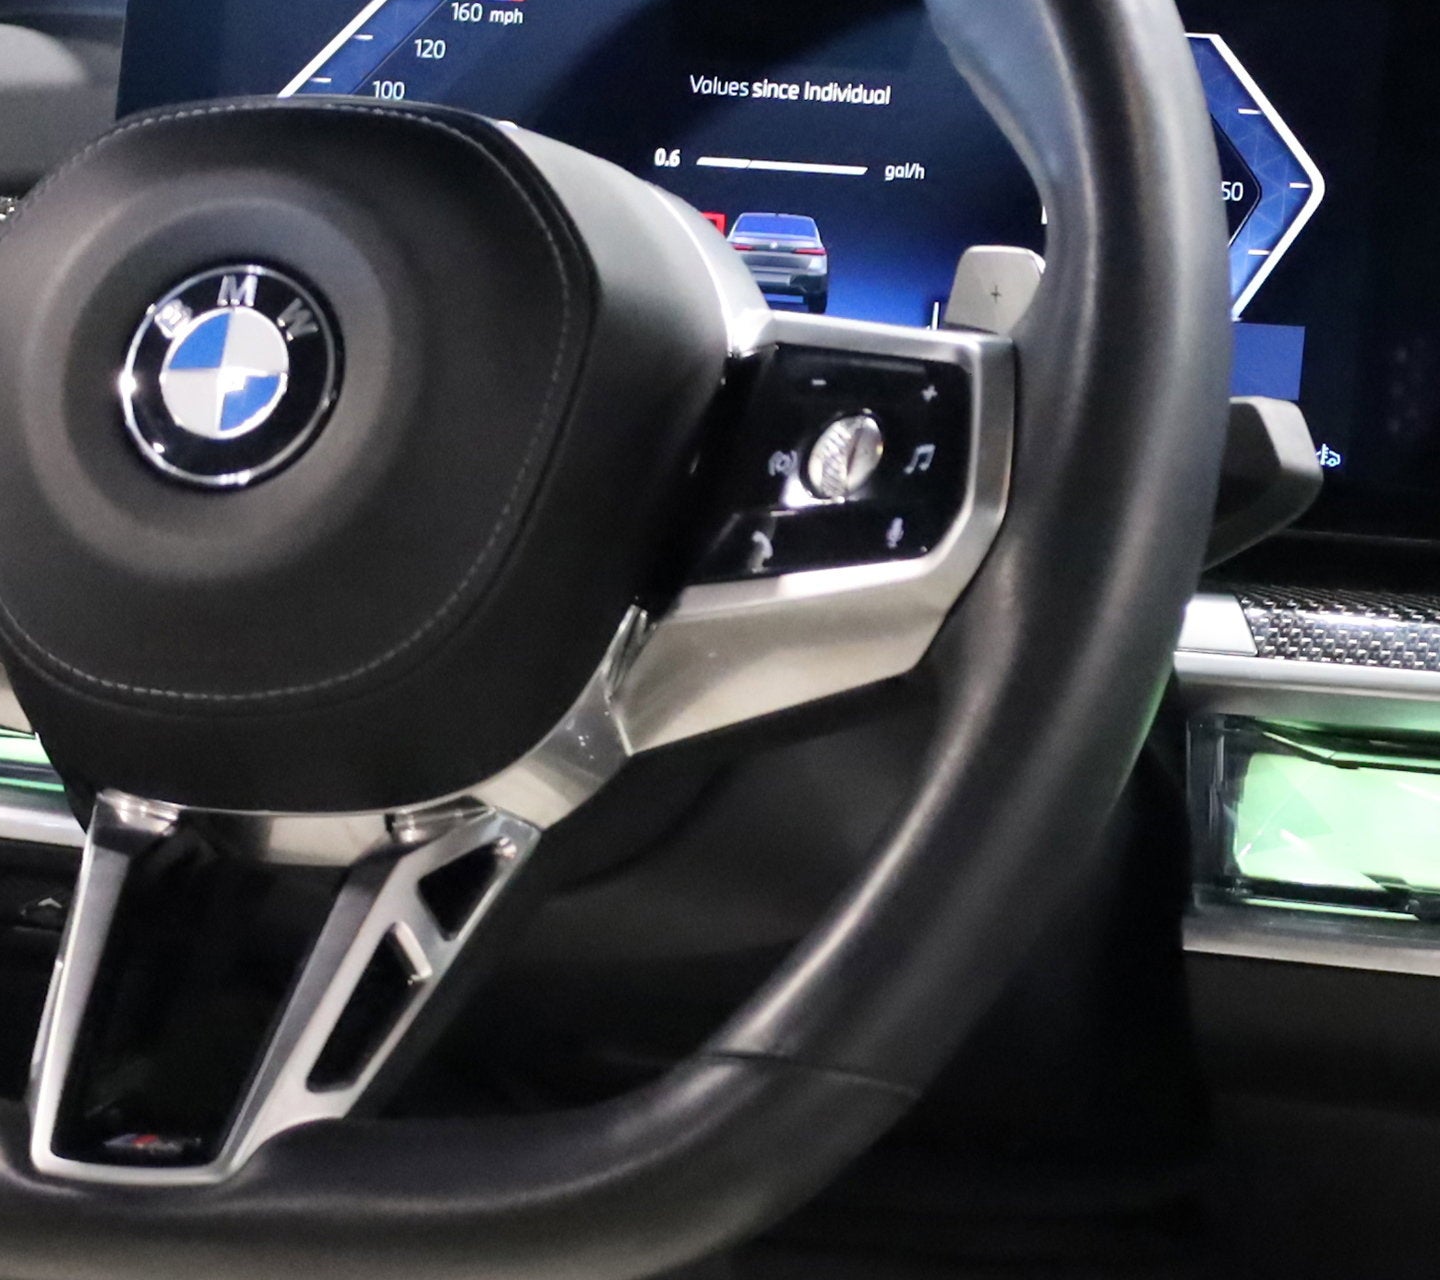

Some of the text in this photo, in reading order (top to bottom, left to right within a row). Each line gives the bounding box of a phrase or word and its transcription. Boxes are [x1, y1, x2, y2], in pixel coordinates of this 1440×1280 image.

[450, 1, 524, 26] 160 mph
[413, 38, 447, 60] 120
[372, 79, 406, 100] 100
[689, 73, 892, 106] Values since Individual
[654, 147, 926, 183] 0.6 gal/h
[154, 275, 319, 342] BMW
